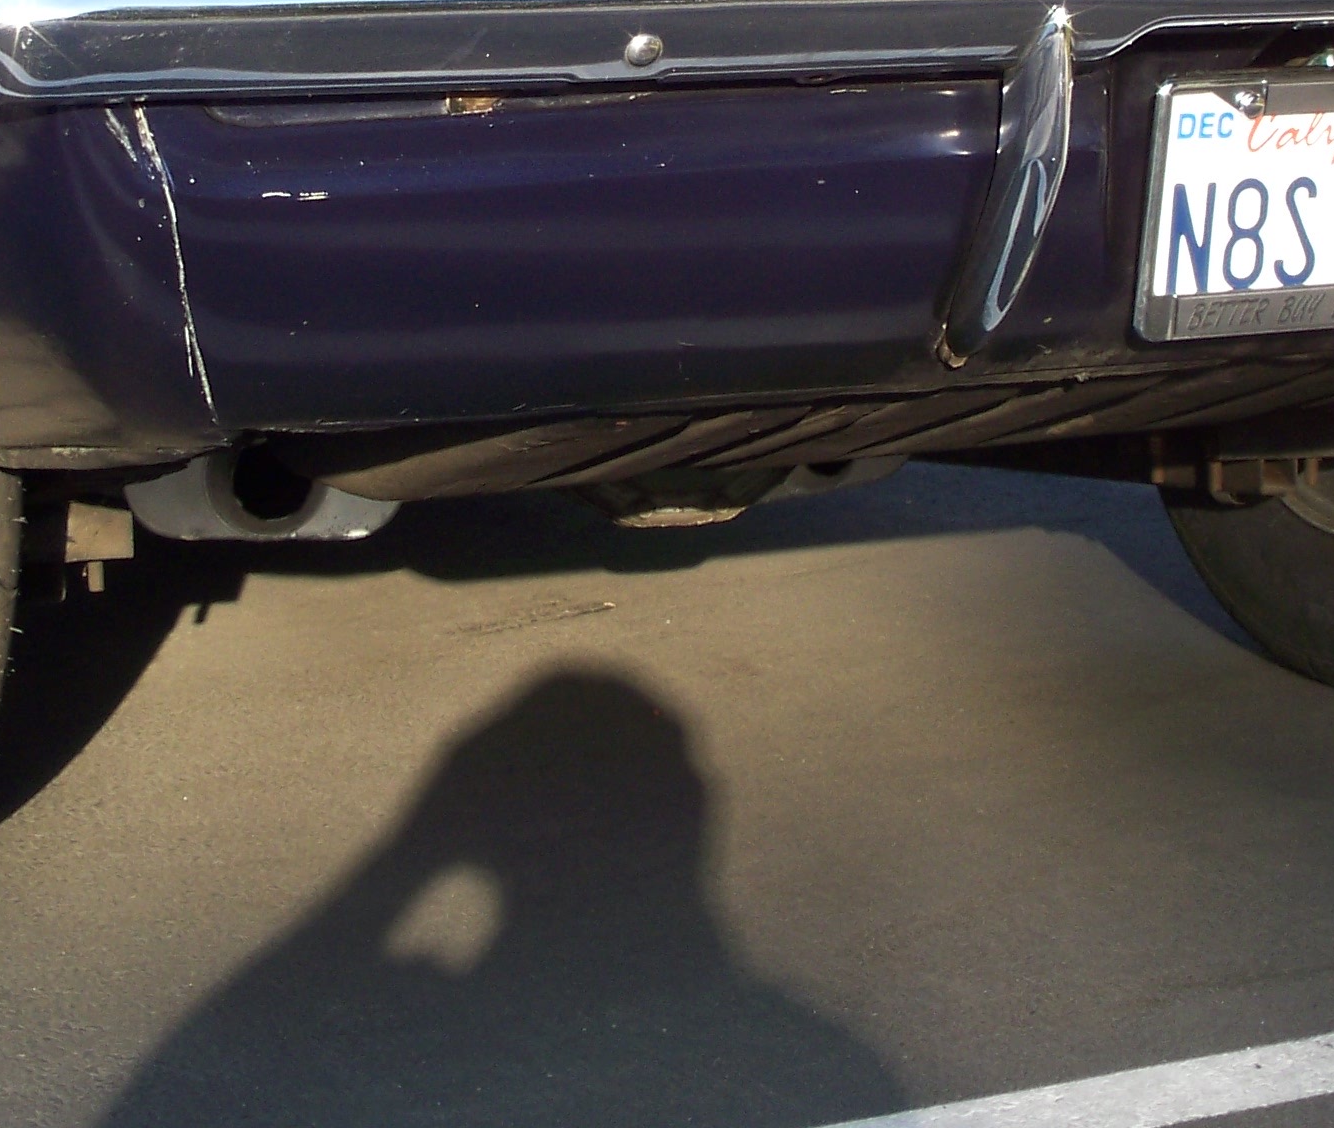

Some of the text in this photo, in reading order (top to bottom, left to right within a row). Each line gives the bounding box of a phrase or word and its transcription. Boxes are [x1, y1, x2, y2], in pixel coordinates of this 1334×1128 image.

[1176, 110, 1235, 140] DEC
[1165, 175, 1318, 295] N8S
[1186, 296, 1271, 332] BETTER
[1275, 292, 1324, 324] BUY
